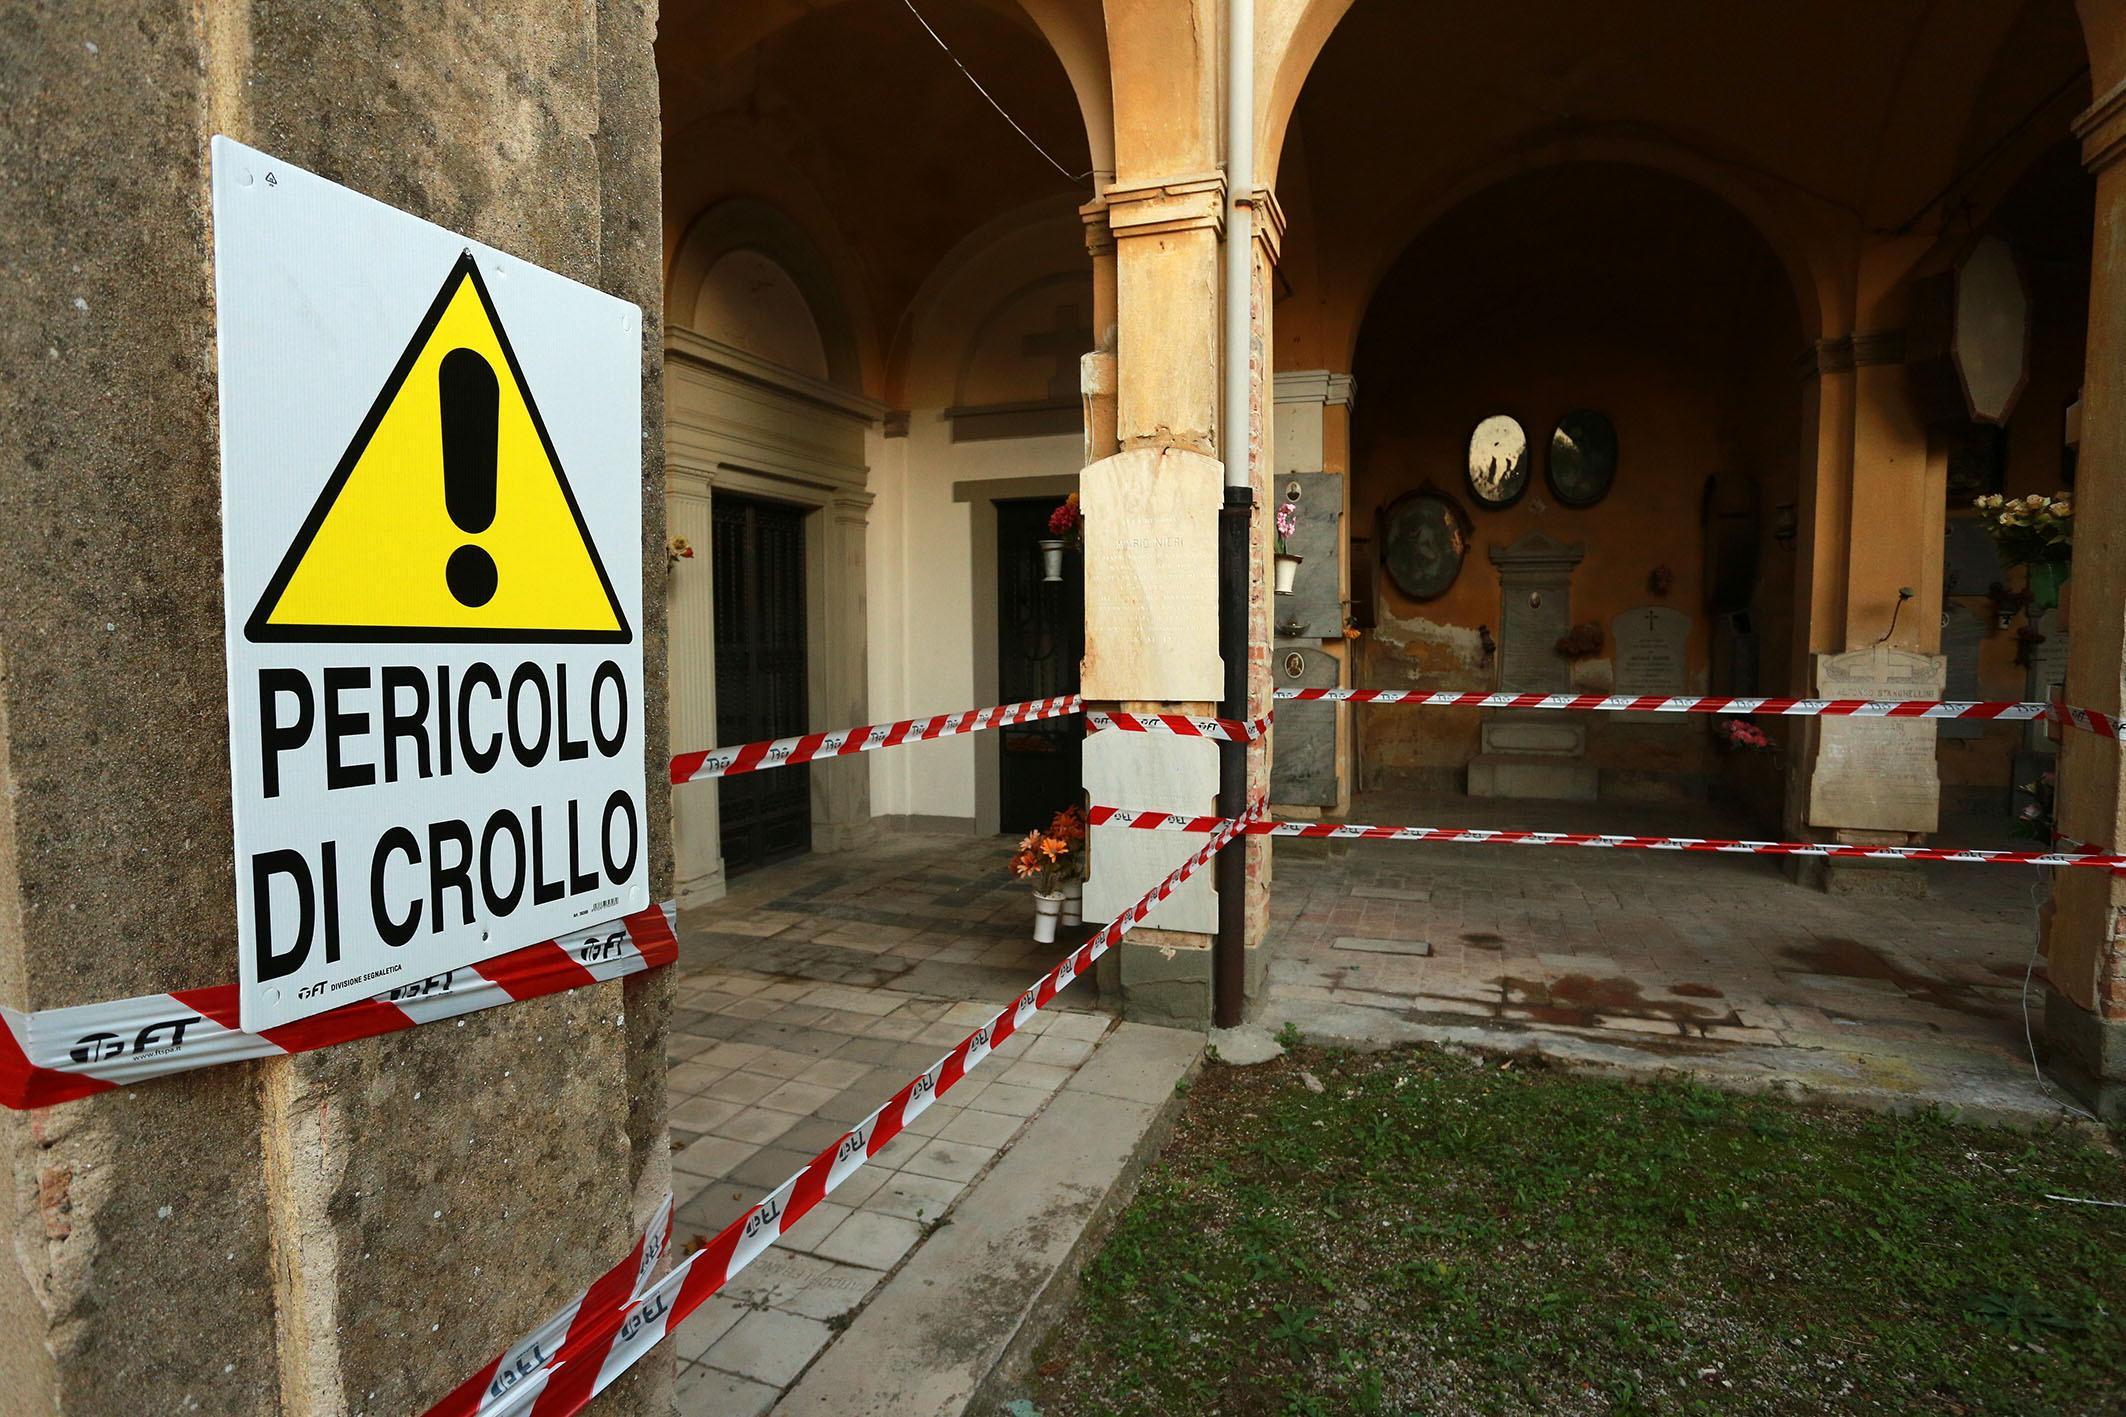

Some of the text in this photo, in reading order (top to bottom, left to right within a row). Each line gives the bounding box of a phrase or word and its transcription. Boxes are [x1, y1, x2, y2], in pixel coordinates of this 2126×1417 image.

[258, 659, 628, 798] PERICOLO
[252, 789, 638, 983] DI CROLLO
[331, 976, 362, 992] DIVISIONE
[363, 964, 402, 982] SEGNALETICA
